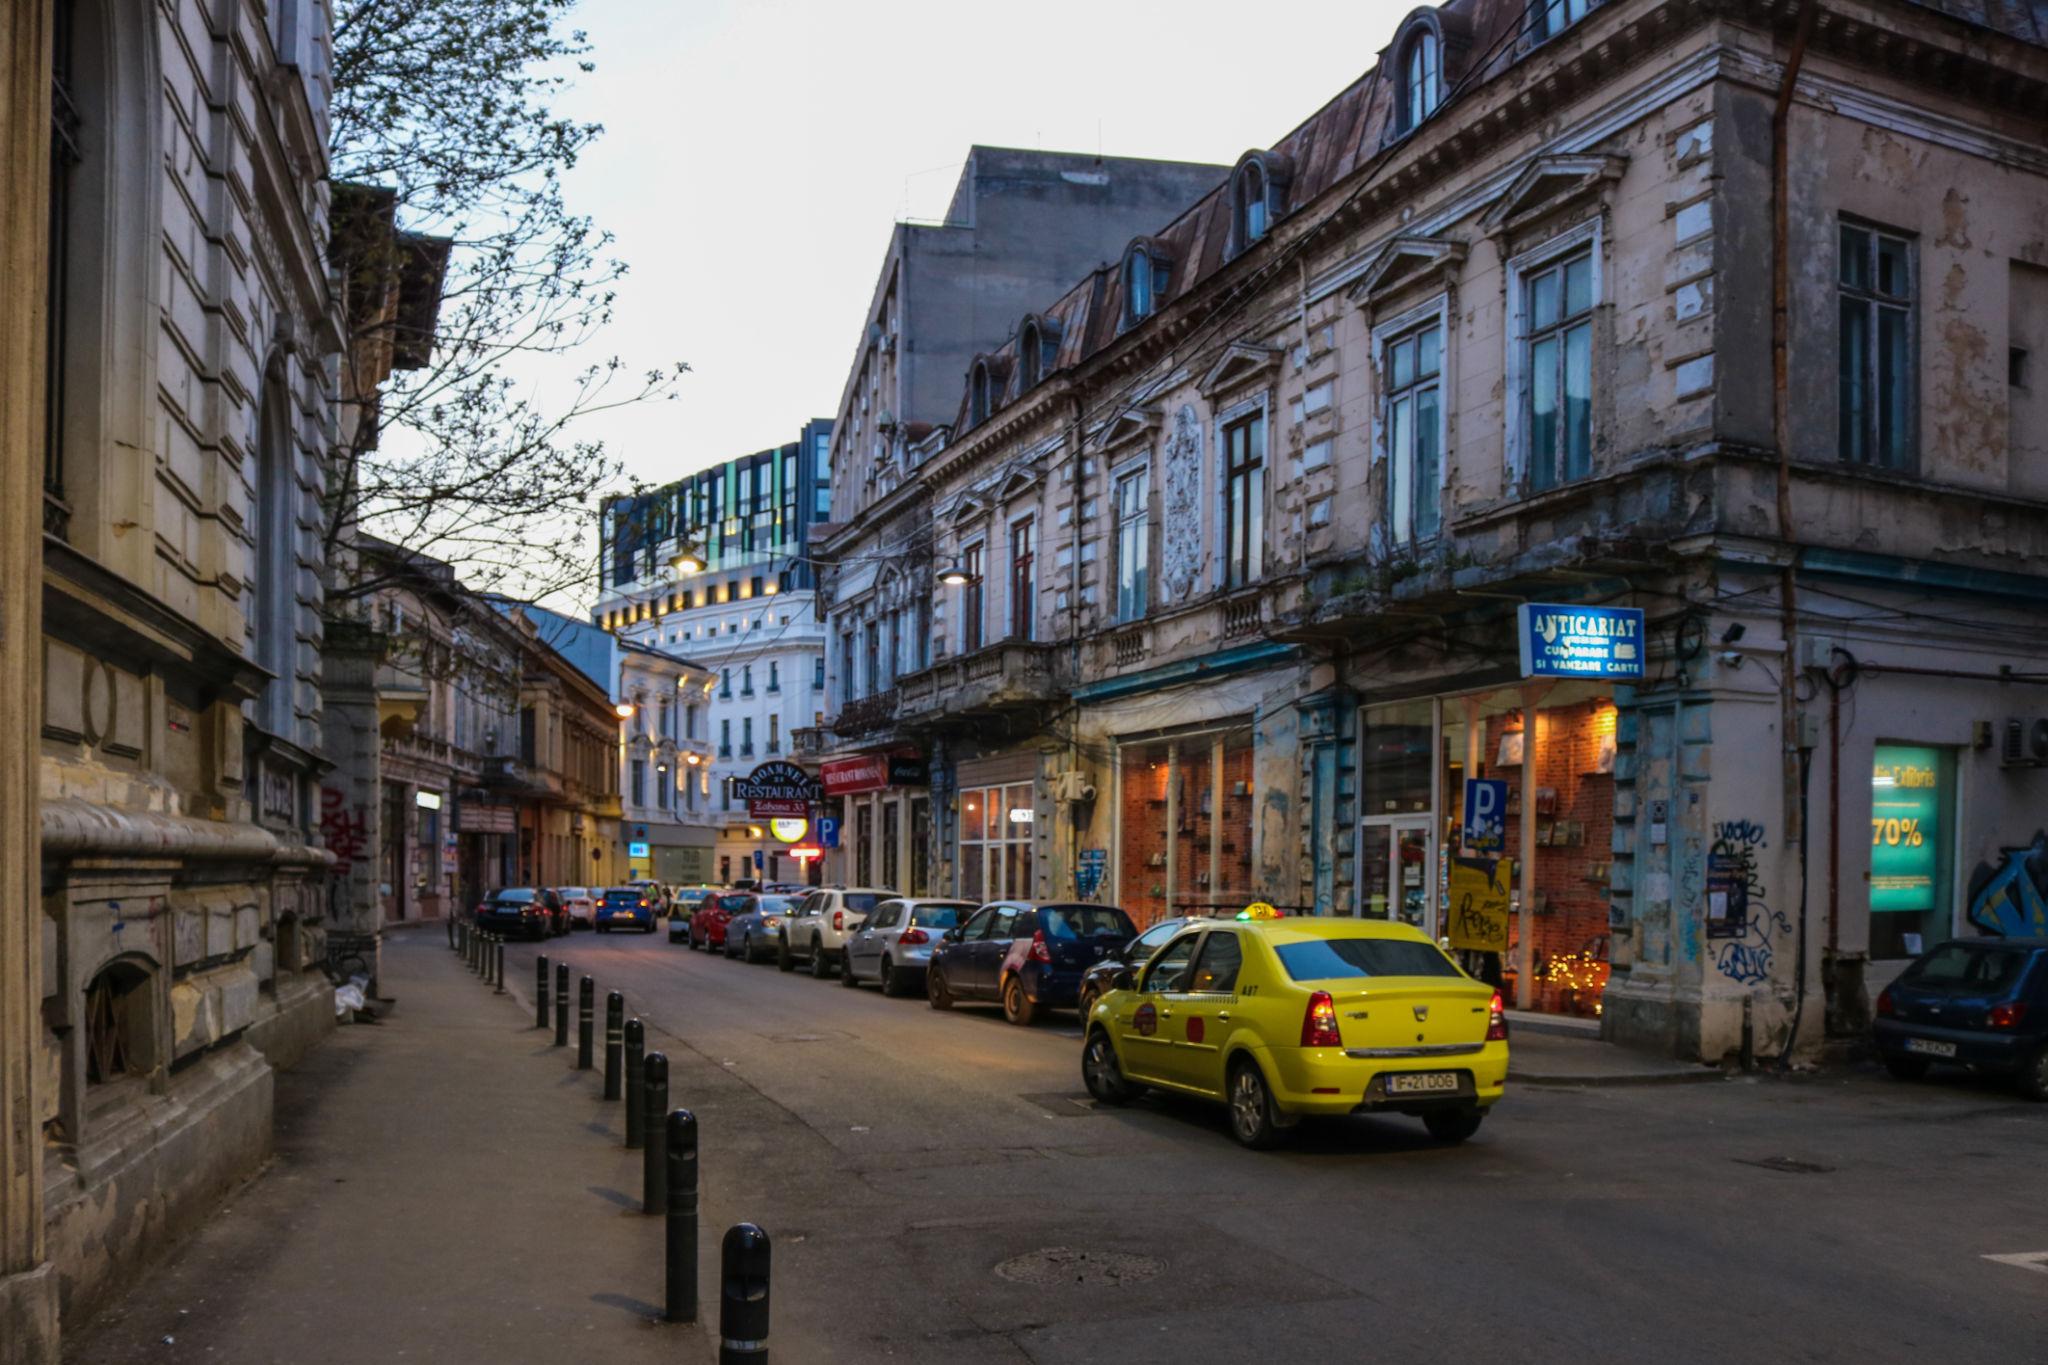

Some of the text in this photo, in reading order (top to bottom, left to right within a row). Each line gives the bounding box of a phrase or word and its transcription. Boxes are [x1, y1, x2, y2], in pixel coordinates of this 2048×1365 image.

[1535, 615, 1636, 638] ANTICARIAT
[1536, 660, 1639, 673] SI VANZARE CARTE
[751, 764, 808, 787] DOAMNEI
[736, 783, 822, 799] RESTAURANT
[1473, 783, 1495, 836] P
[822, 820, 833, 843] P
[1872, 818, 1922, 847] 70%
